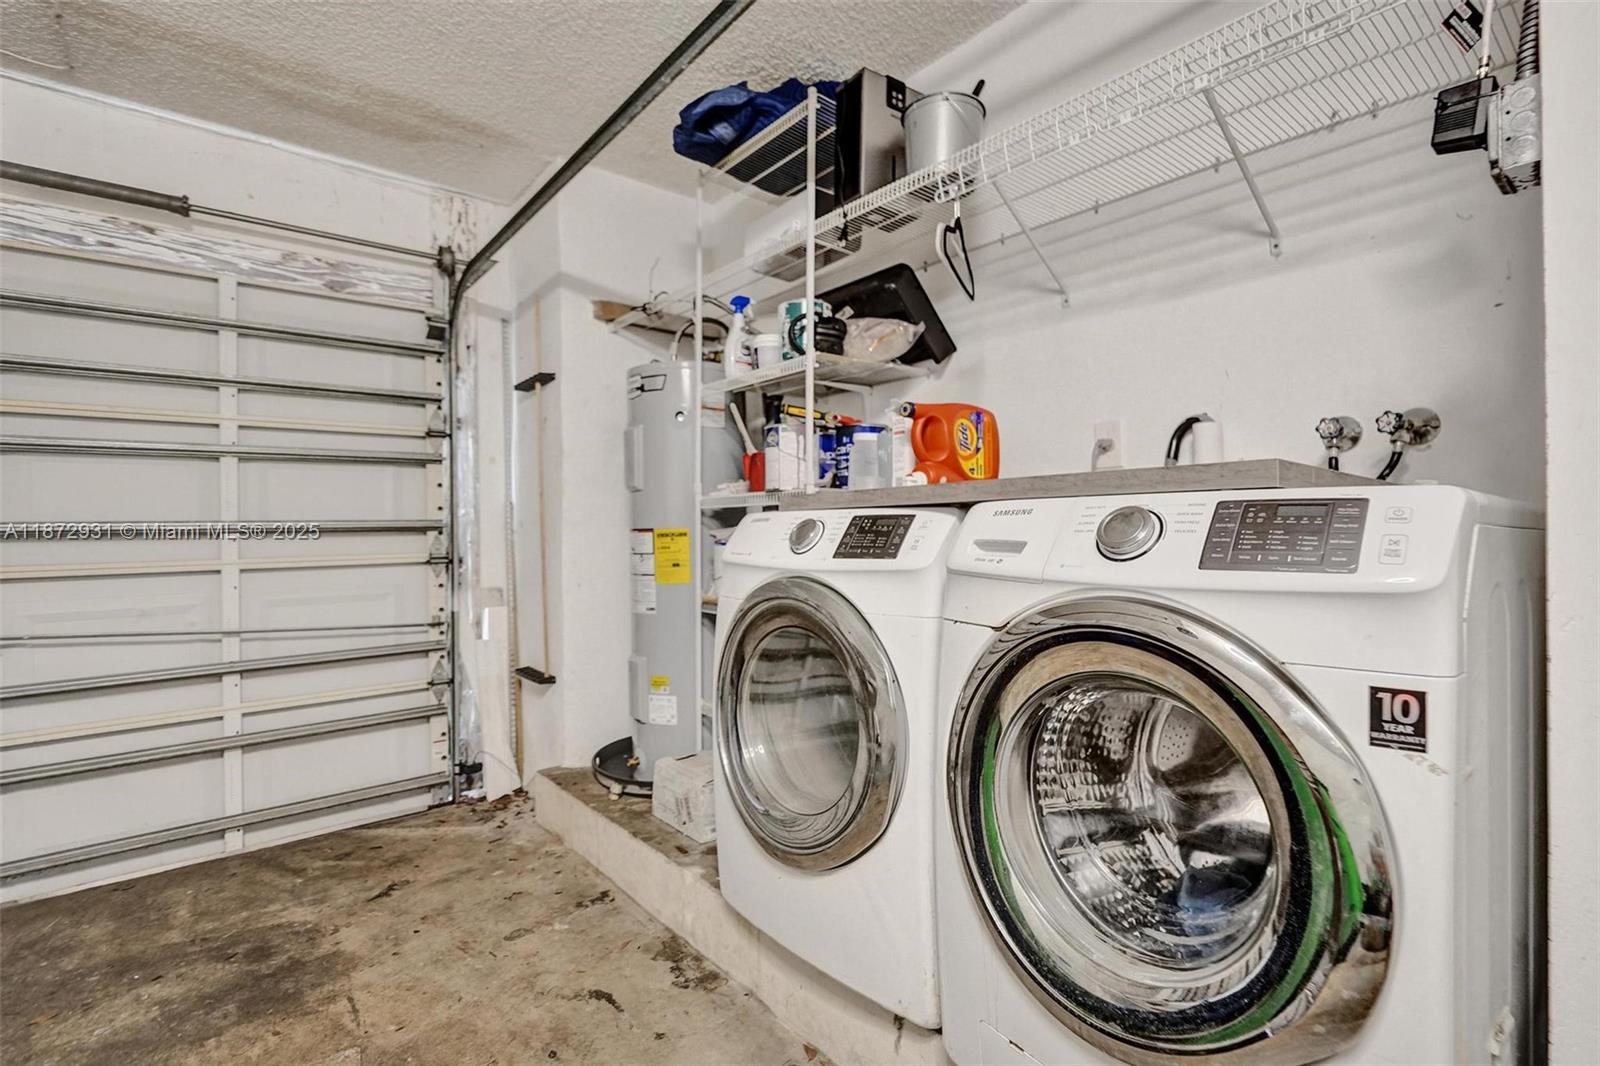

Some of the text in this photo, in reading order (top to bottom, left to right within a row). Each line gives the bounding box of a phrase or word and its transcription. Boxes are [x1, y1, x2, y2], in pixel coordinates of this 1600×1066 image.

[959, 422, 972, 451] Tide
[992, 508, 1034, 517] SAMSUNG
[1375, 691, 1421, 724] 10
[1381, 721, 1416, 736] YEAR
